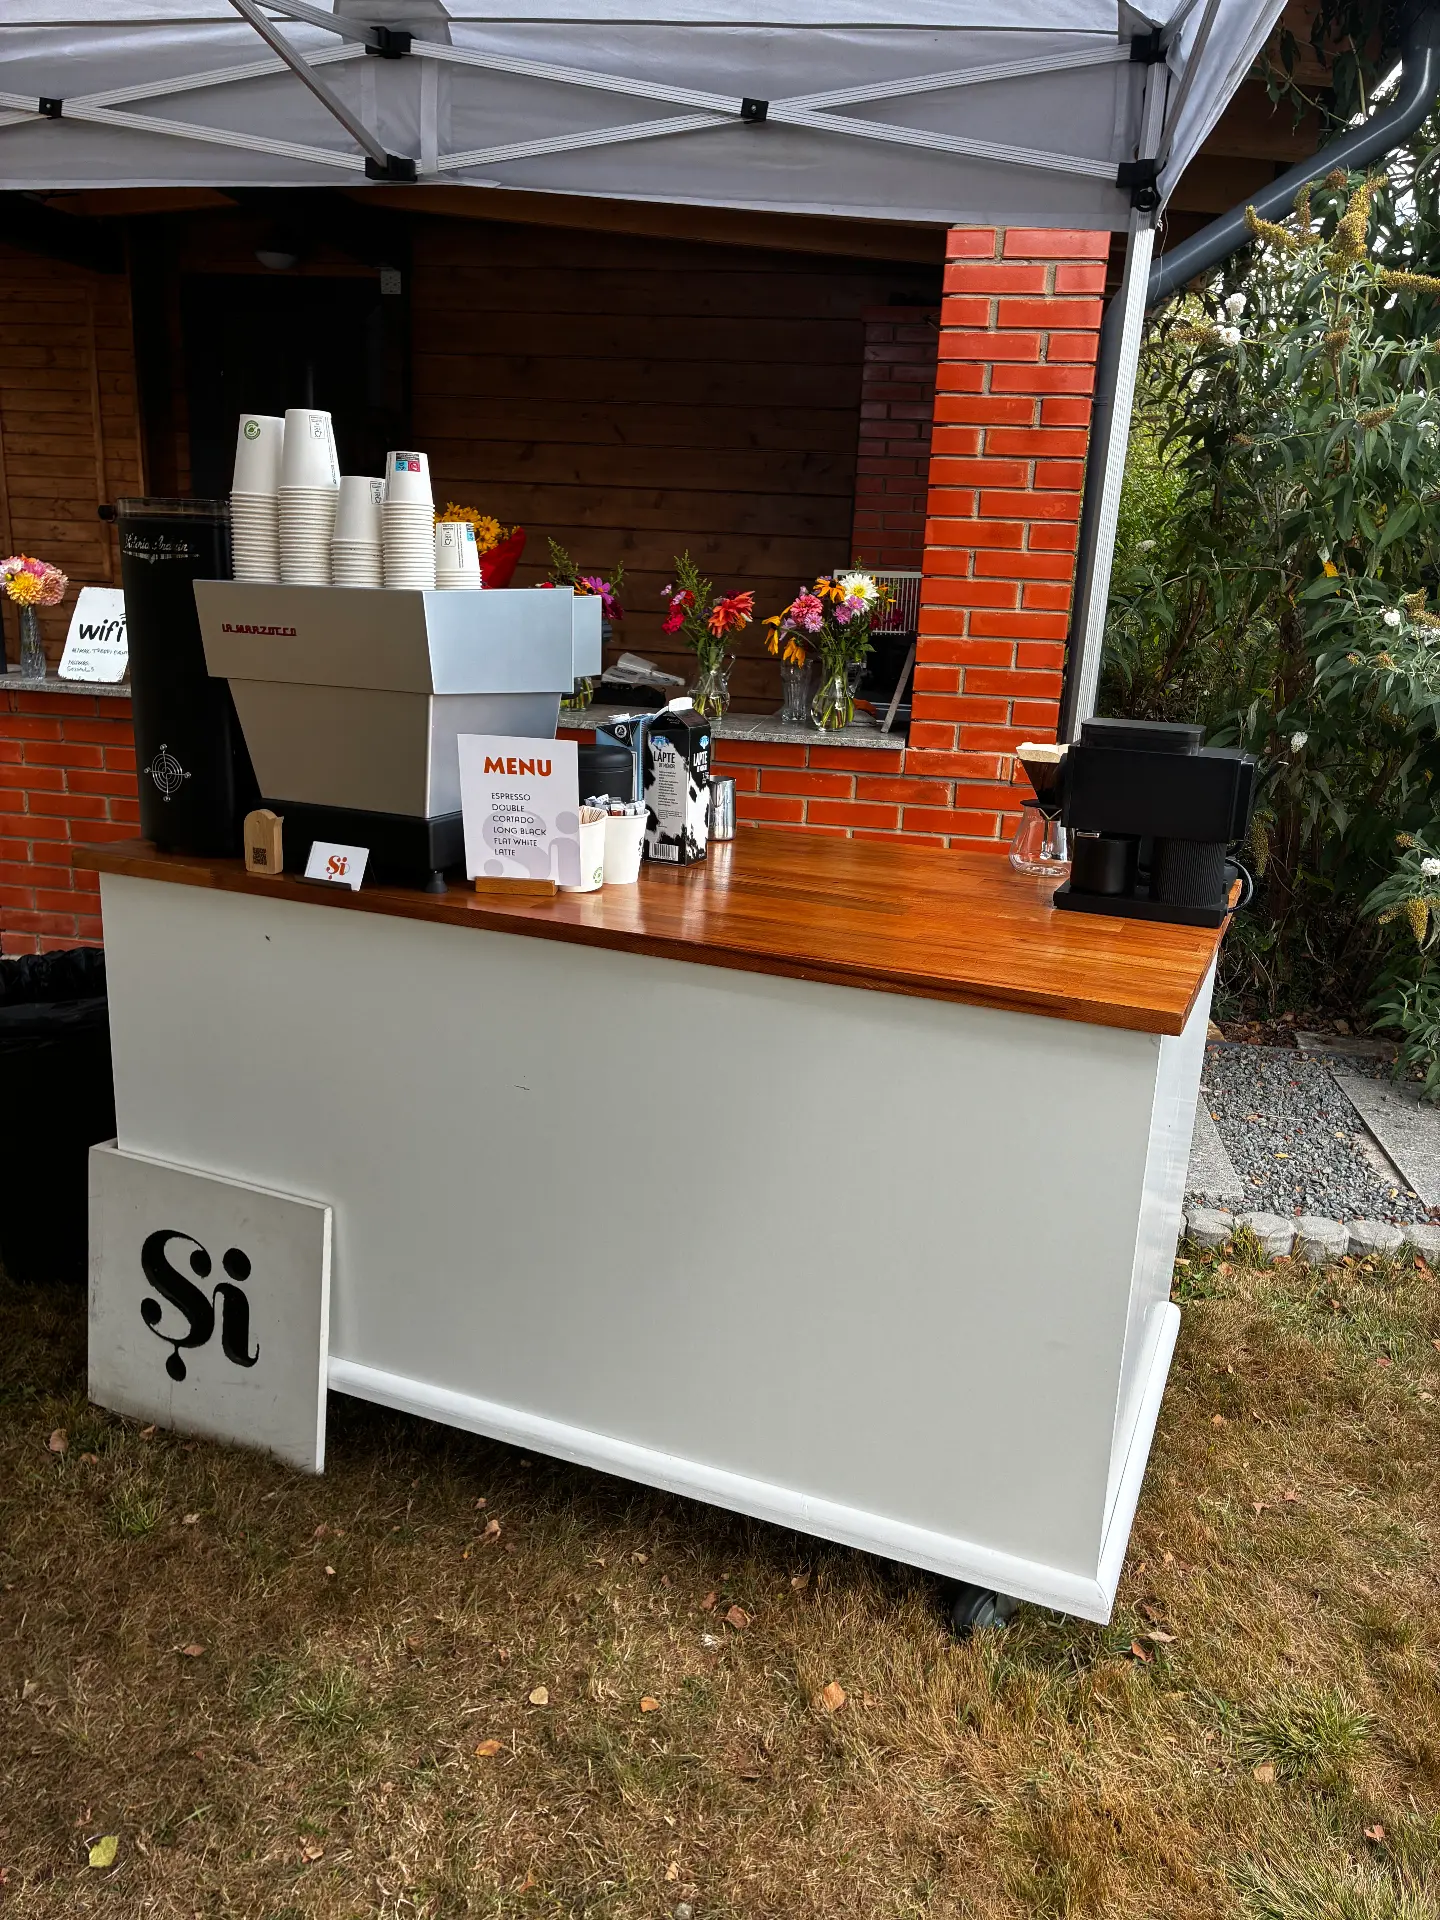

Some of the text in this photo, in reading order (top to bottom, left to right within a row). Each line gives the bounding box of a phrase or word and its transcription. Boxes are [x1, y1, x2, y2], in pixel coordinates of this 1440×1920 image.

[79, 618, 126, 643] wifi
[653, 750, 676, 764] LAPTE
[483, 756, 552, 777] MENU
[491, 792, 531, 802] ESPRESSO
[491, 803, 525, 813] DOUBLE
[492, 815, 535, 824] CORTADO
[493, 826, 547, 836] LONG BLACK
[494, 837, 538, 847] FLAT WHITE
[494, 848, 516, 856] LATTE
